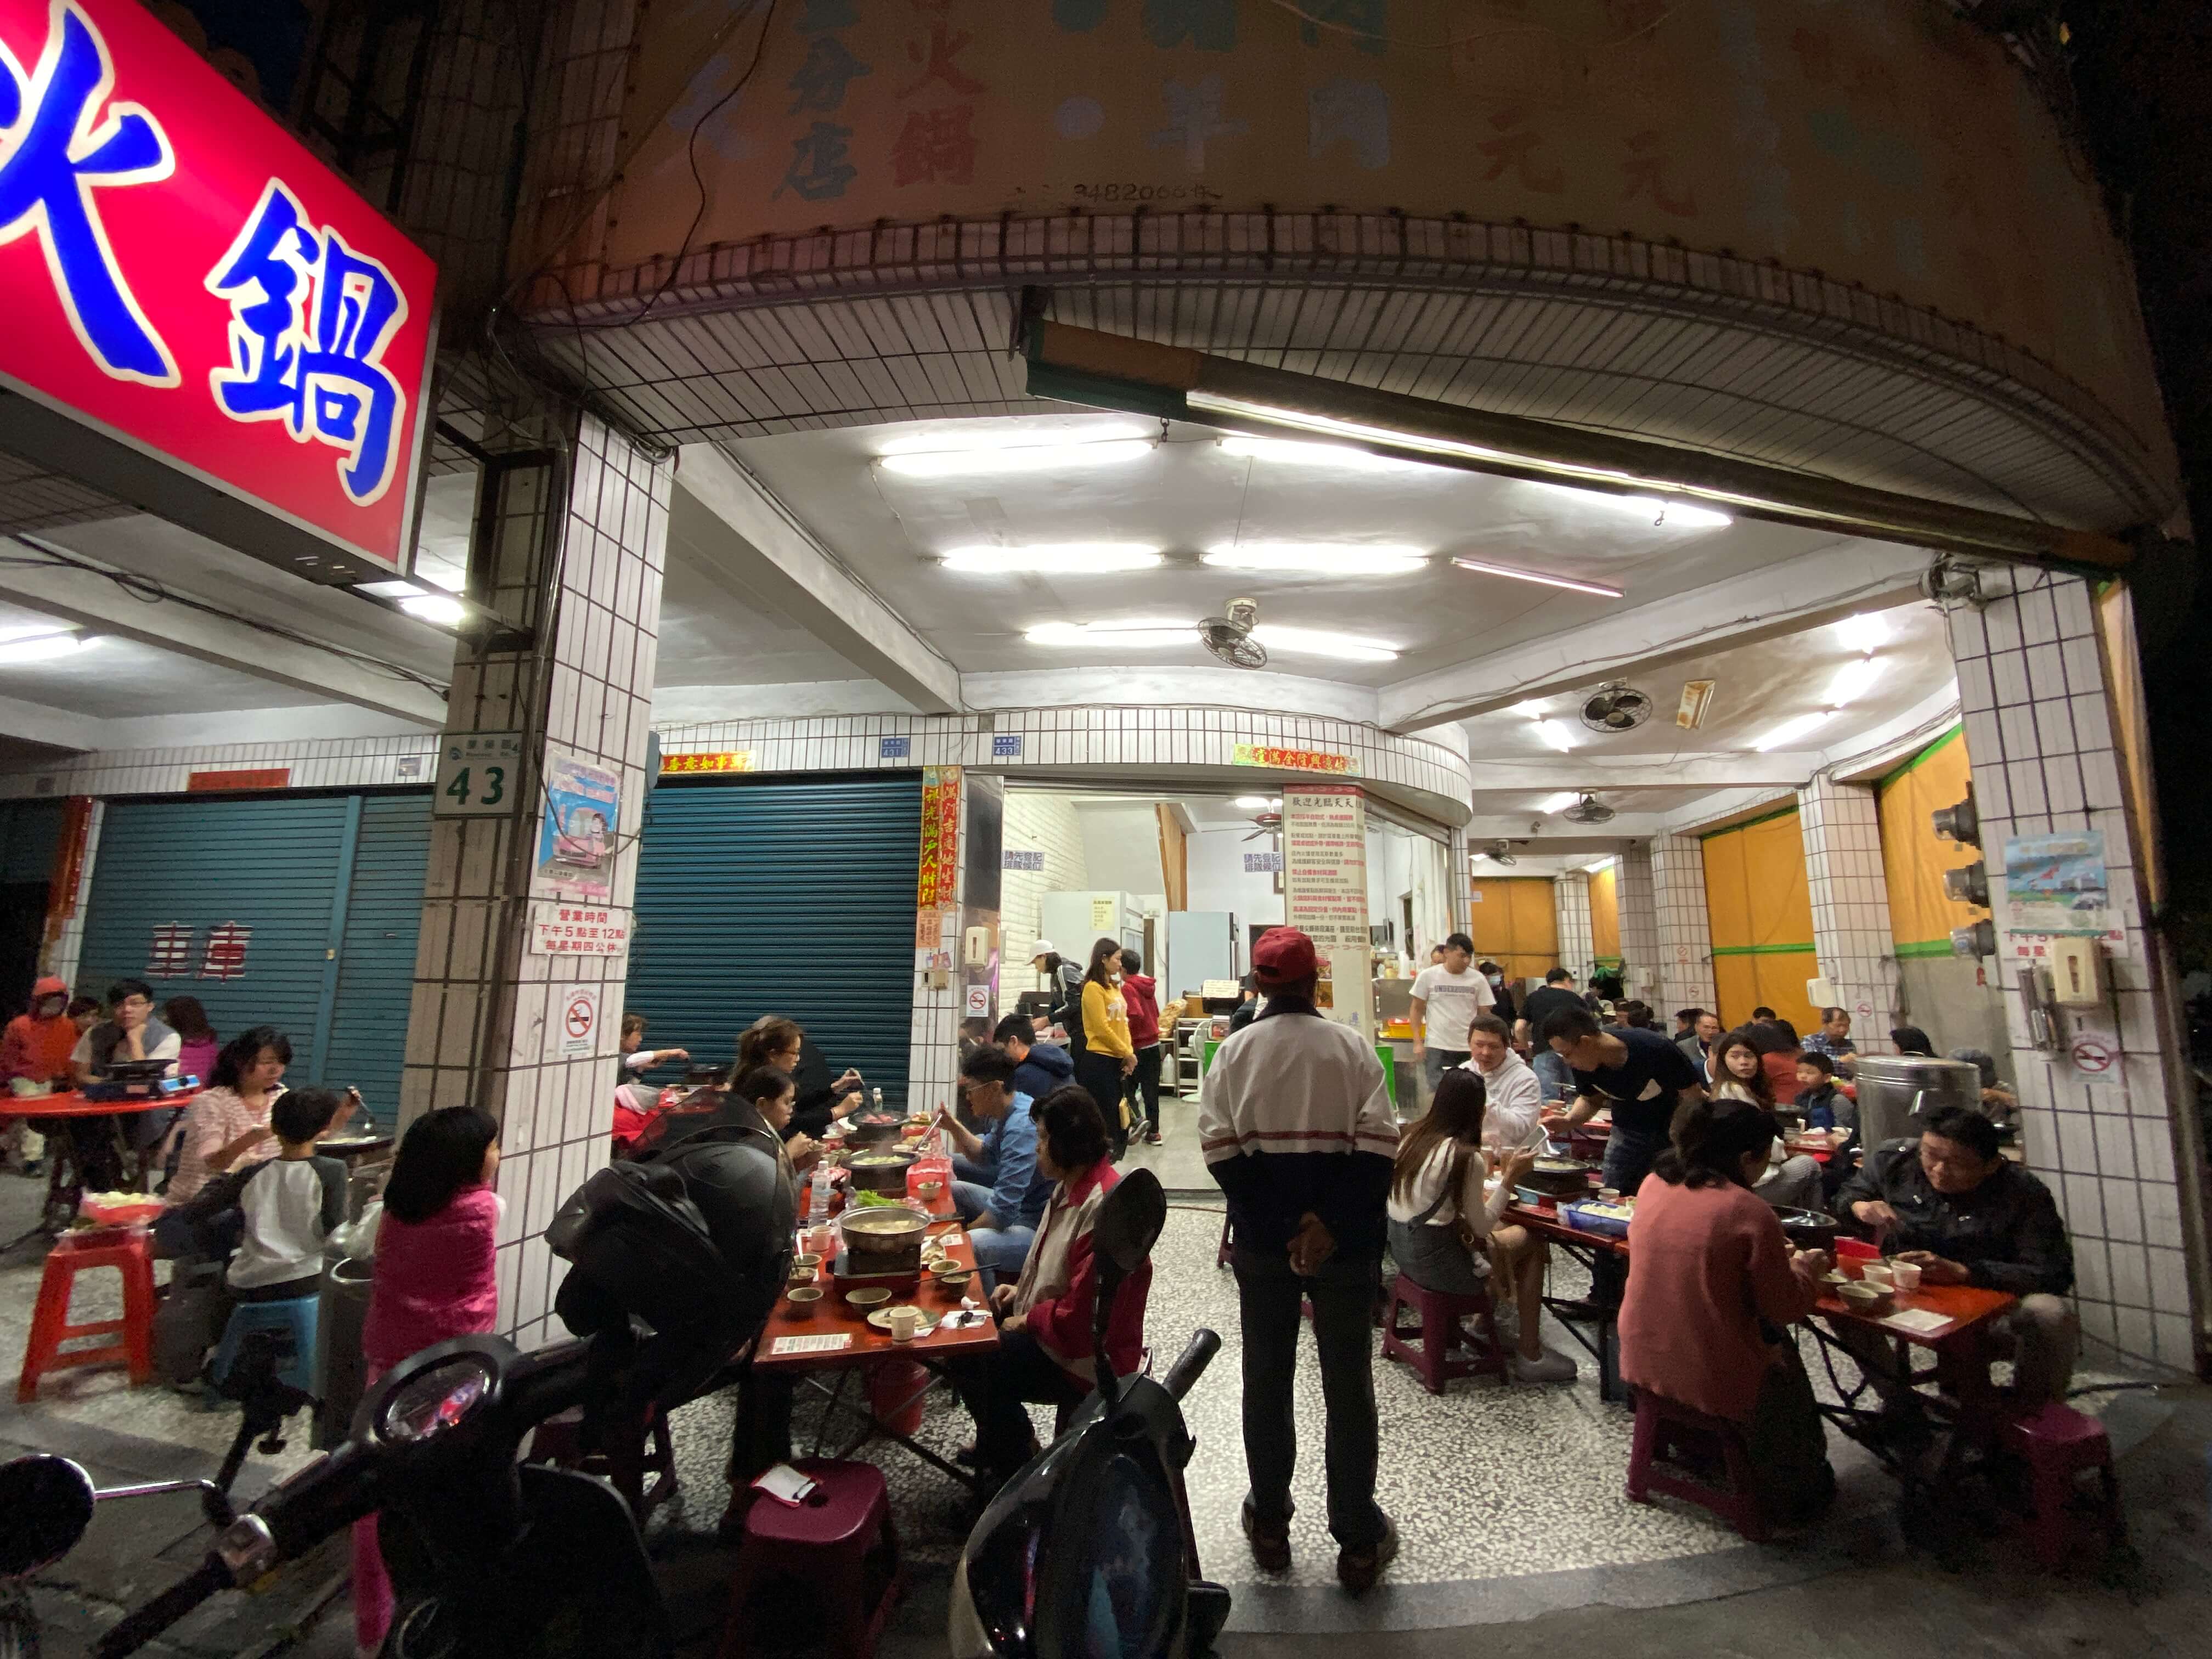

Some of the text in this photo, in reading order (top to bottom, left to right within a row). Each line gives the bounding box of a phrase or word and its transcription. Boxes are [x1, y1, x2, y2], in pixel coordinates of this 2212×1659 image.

[890, 0, 986, 188] 火鍋
[445, 766, 505, 805] 43
[559, 909, 607, 924] 營業時間
[545, 940, 616, 952] 每星期四公休
